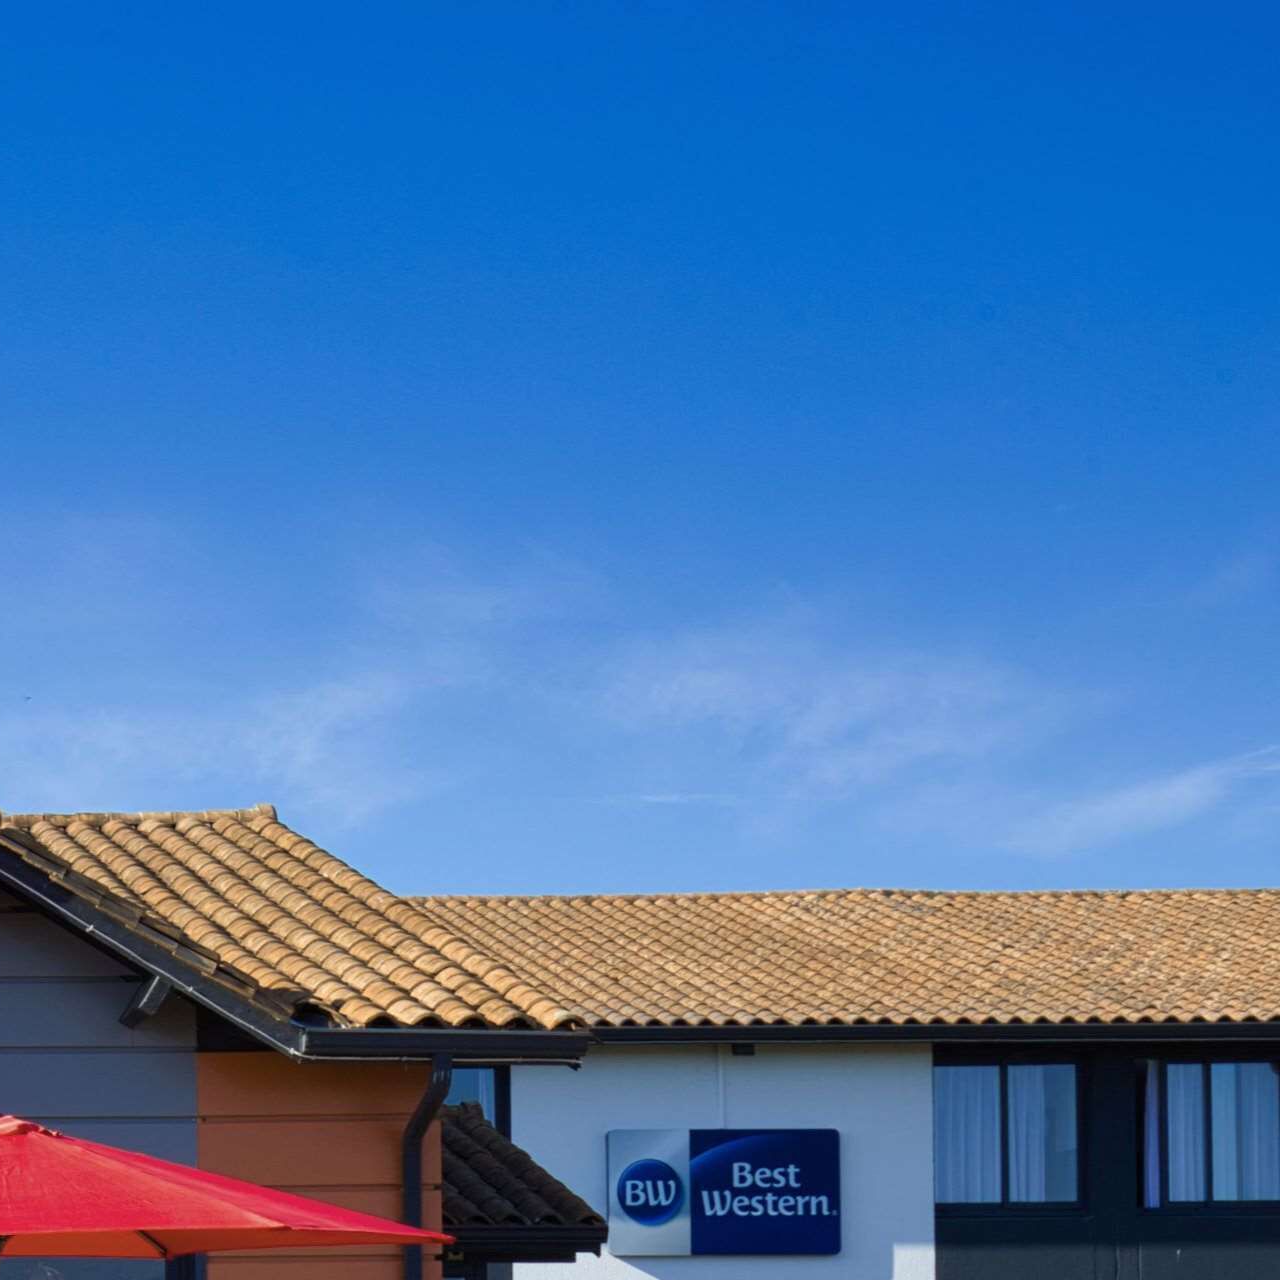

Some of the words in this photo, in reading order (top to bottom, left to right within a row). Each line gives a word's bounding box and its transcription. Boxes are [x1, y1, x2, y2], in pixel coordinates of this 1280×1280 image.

[732, 1162, 801, 1188] Best
[625, 1180, 676, 1206] BW
[701, 1191, 830, 1216] Western
